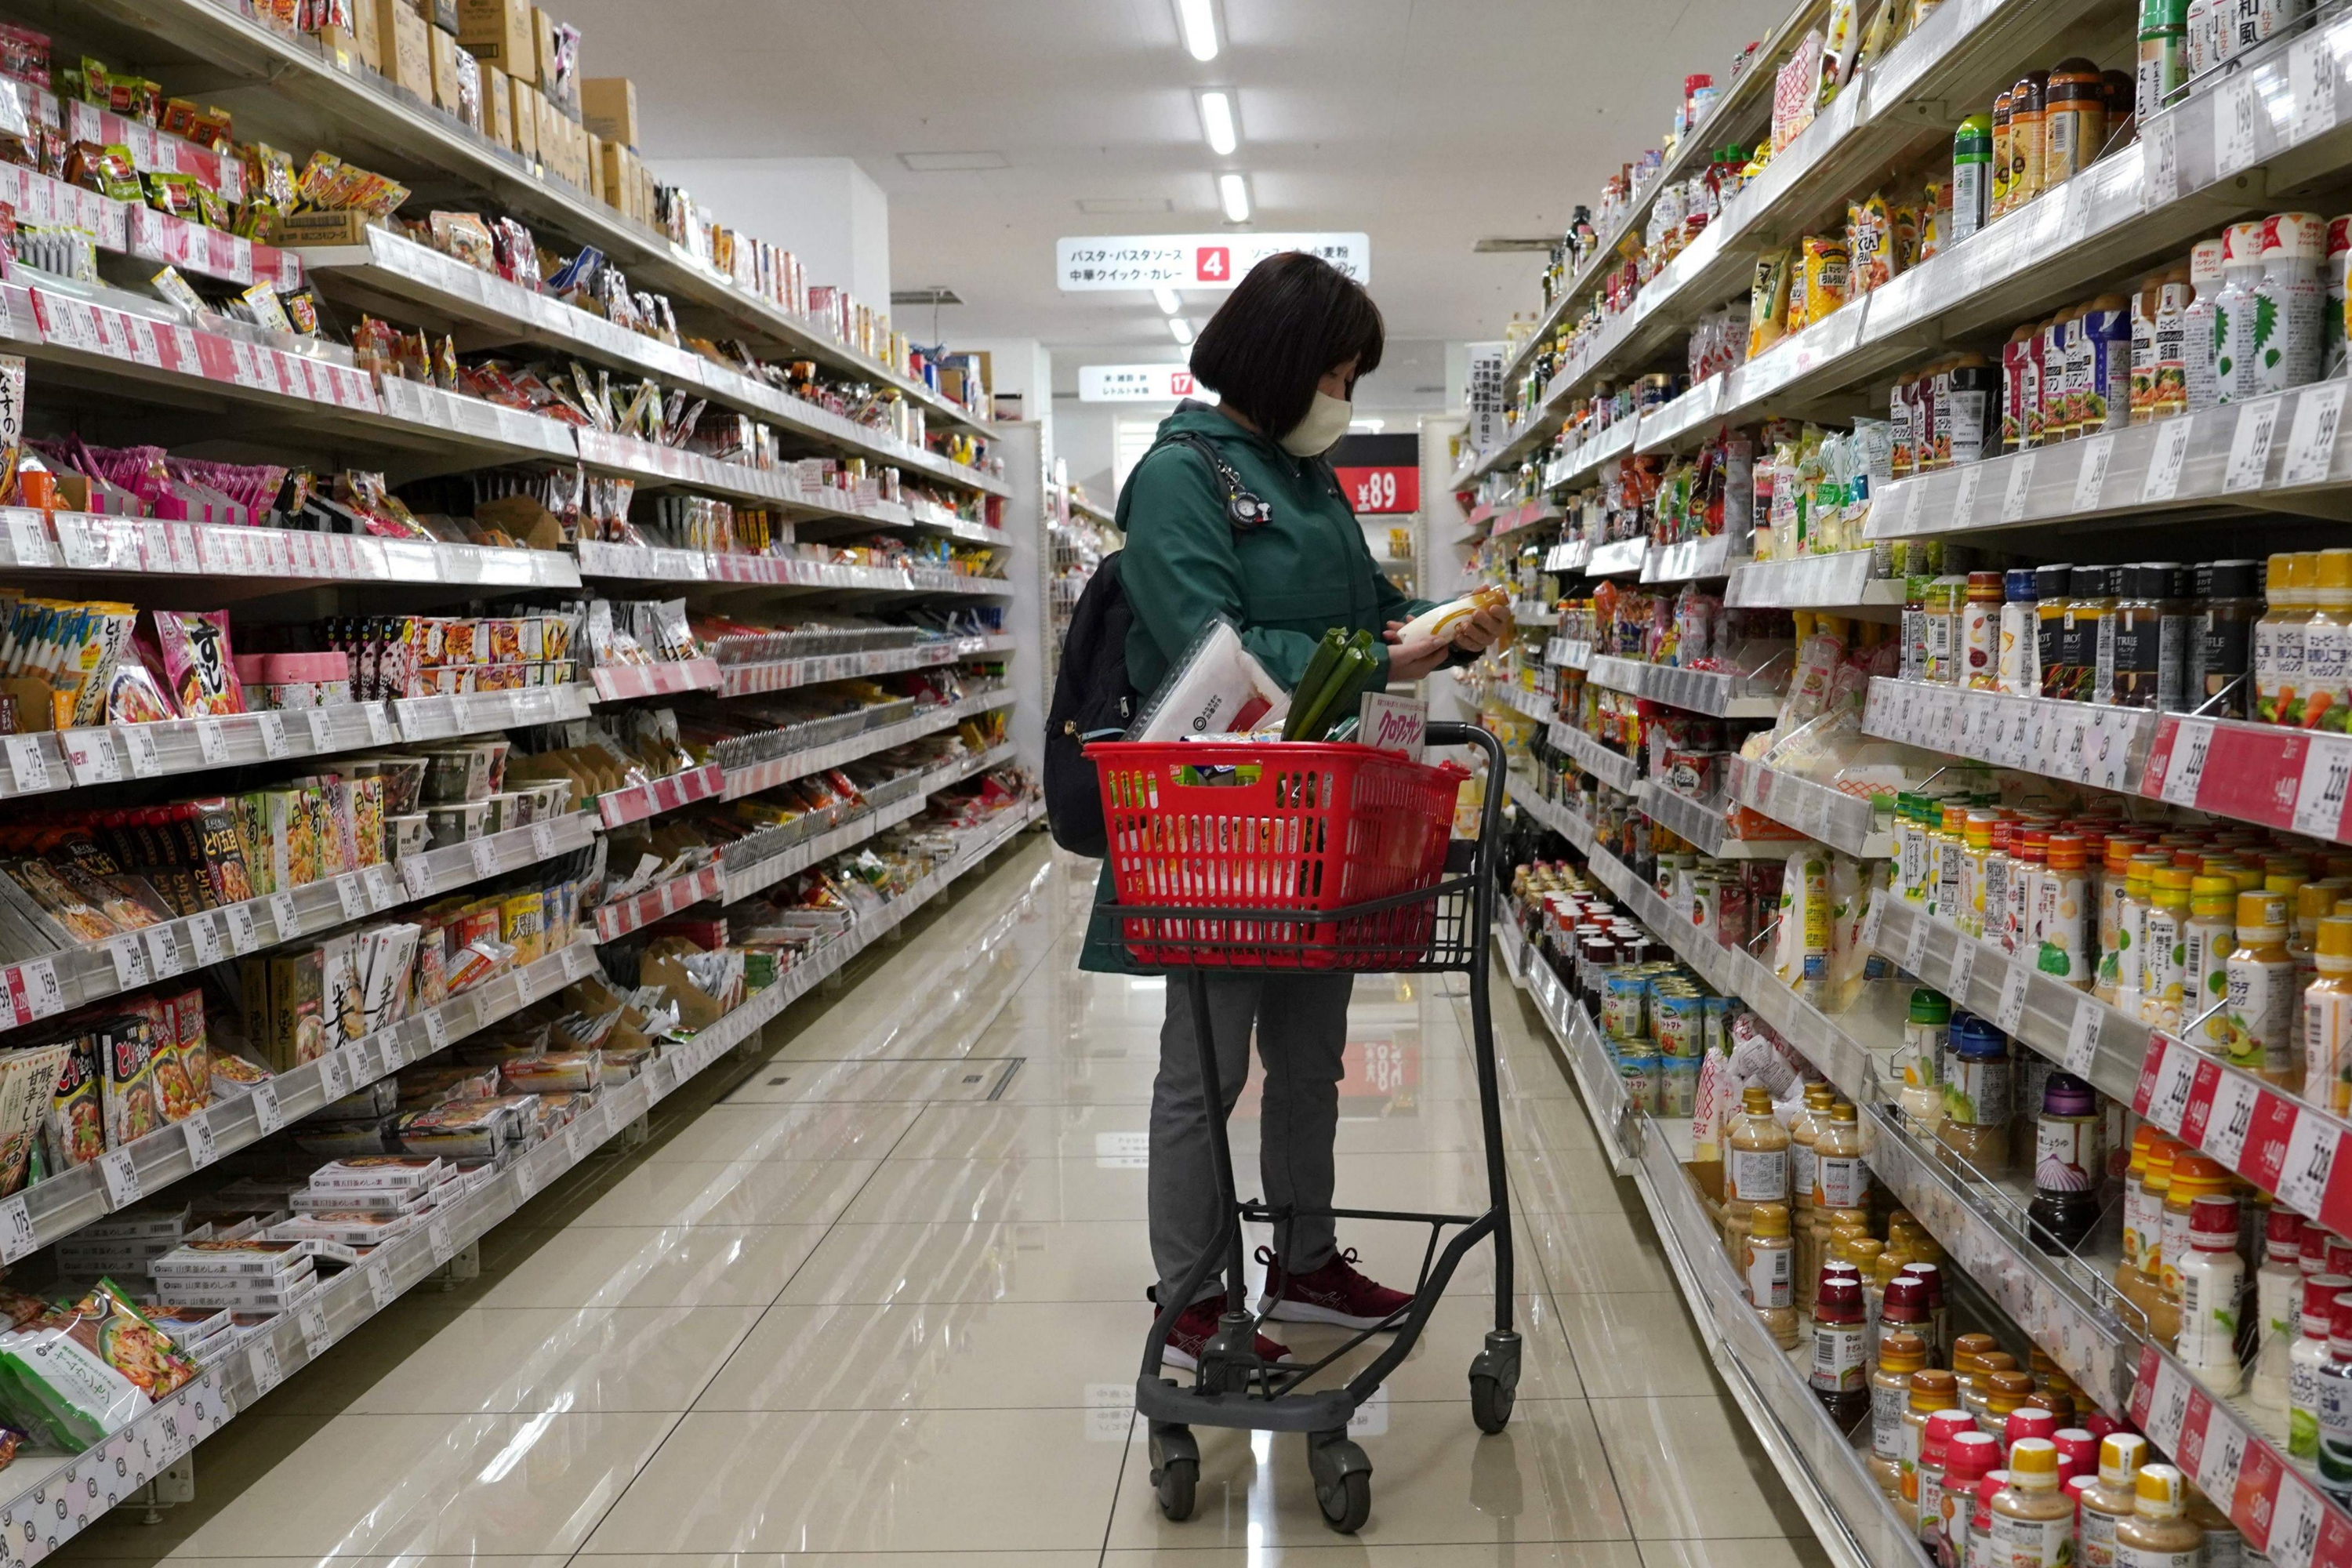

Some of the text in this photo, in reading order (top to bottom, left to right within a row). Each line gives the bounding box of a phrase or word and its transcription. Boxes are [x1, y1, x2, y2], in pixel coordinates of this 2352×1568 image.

[88, 119, 100, 139] 119
[137, 137, 149, 152] 119
[163, 147, 175, 161] 119
[6, 180, 19, 201] 119
[36, 191, 49, 211] 119
[64, 199, 75, 220] 119
[88, 207, 100, 227] 119
[112, 213, 124, 233] 119
[287, 263, 297, 282] 119
[1203, 251, 1223, 277] 4
[55, 305, 70, 328] 119
[79, 313, 95, 334] 119
[109, 321, 125, 342] 119
[140, 328, 154, 348] 119
[1172, 375, 1191, 393] 17
[2314, 408, 2337, 445] 199
[2251, 421, 2271, 456] 199
[153, 535, 167, 555] 119
[180, 535, 194, 555] 119
[25, 749, 42, 769] 175
[203, 828, 238, 856] とり五目
[127, 947, 142, 968] 299
[41, 974, 57, 995] 159
[116, 1040, 138, 1078] とり
[198, 1127, 212, 1147] 199
[120, 1162, 135, 1185] 199
[12, 1212, 30, 1234] 175
[162, 1417, 177, 1443] 198
